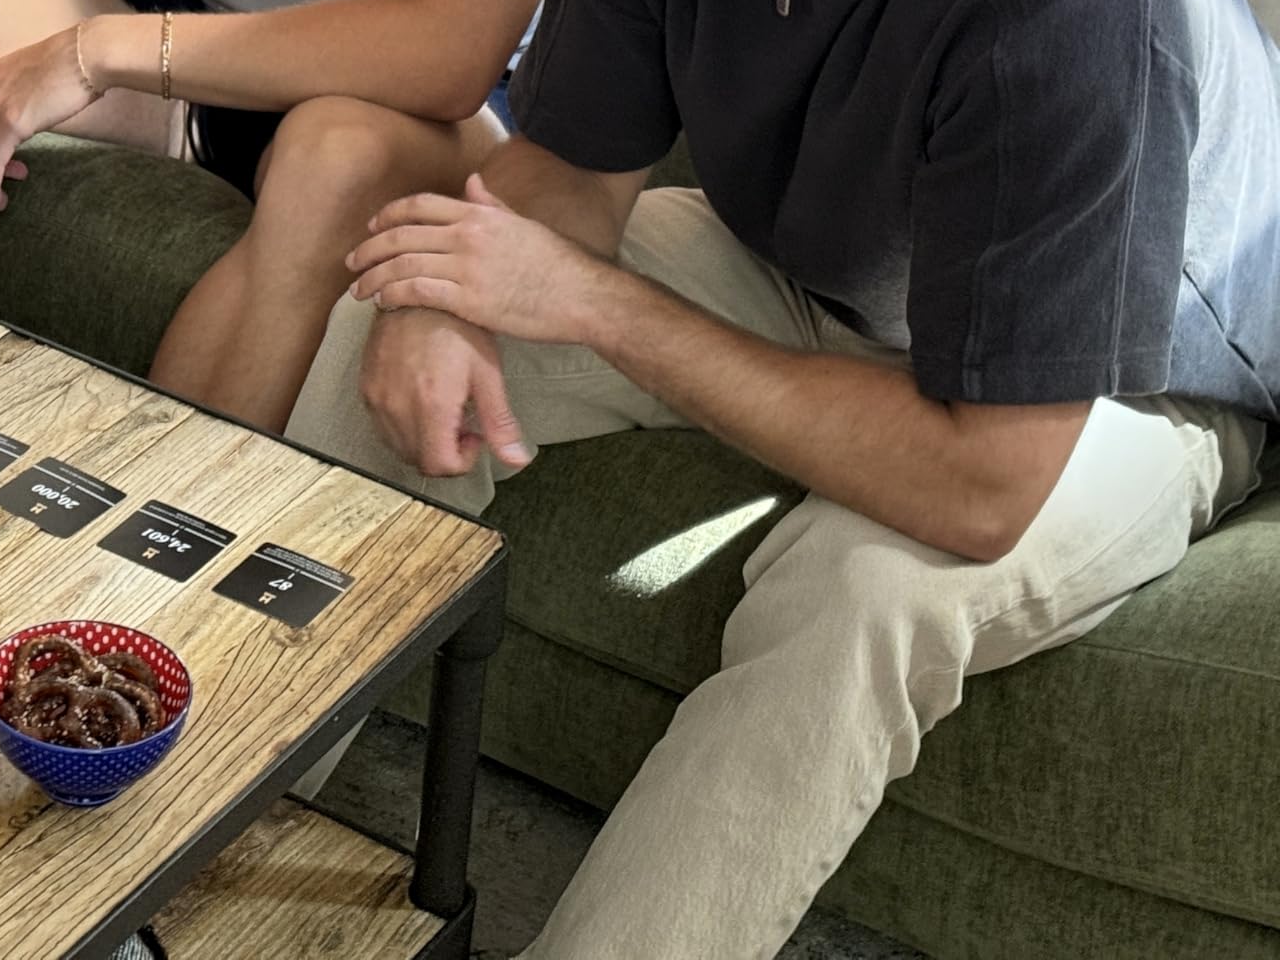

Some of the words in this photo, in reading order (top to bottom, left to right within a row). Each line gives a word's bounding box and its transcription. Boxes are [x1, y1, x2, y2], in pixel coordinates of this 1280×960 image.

[31, 484, 80, 509] 20,000
[140, 528, 192, 552] 24,601
[268, 579, 293, 591] 87
